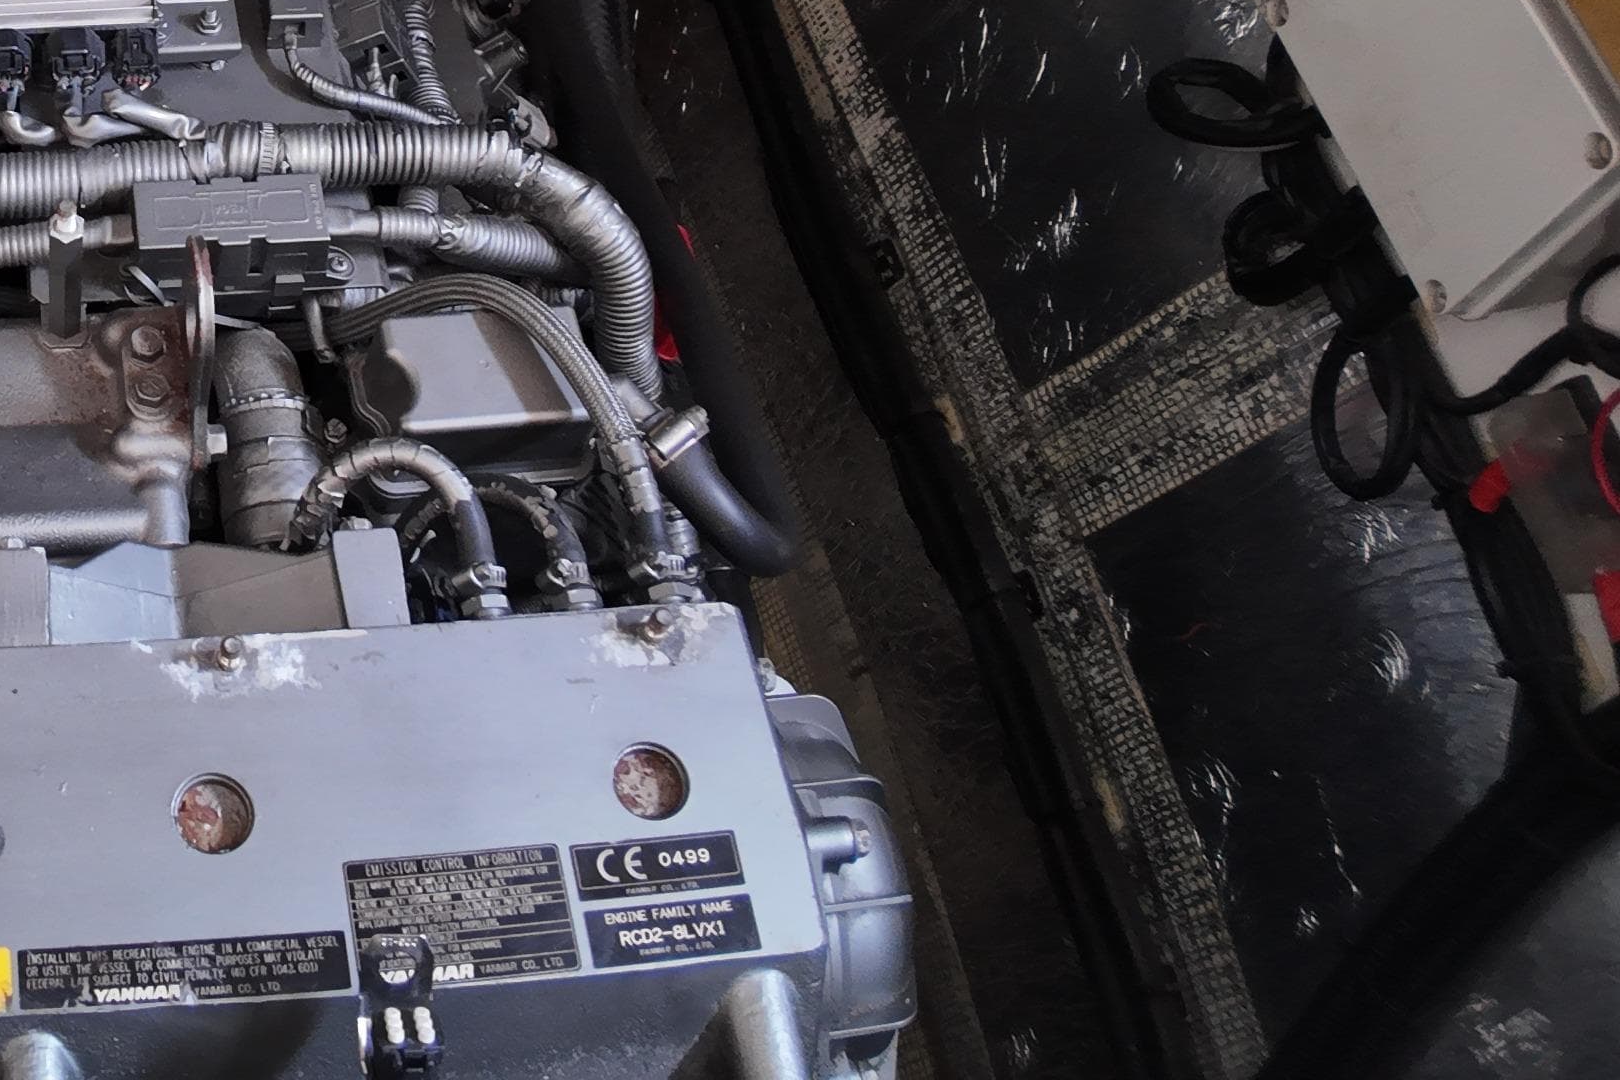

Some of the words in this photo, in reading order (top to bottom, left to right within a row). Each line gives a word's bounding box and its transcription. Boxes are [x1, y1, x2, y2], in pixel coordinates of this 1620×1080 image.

[365, 860, 418, 877] EMISSION
[422, 857, 467, 872] CONTROL
[474, 849, 542, 868] INFORMATION
[596, 846, 648, 883] CE
[658, 848, 711, 867] 0499
[604, 909, 648, 925] ENGINE
[651, 904, 697, 920] FAMILY
[701, 900, 733, 914] NAME
[619, 920, 726, 947] RCD2-8LVX1
[26, 965, 39, 977] OR
[42, 964, 71, 977] USING
[99, 961, 129, 973] VESSEL
[135, 959, 153, 971] FOR
[216, 953, 260, 966] PURPOSES
[263, 952, 282, 963] MAY
[287, 948, 324, 961] VIOLATE
[27, 952, 82, 965] INSTALLING
[87, 950, 109, 962] THIS
[183, 944, 215, 956] ENGINE
[221, 943, 232, 954] IN
[236, 943, 243, 953] A
[306, 936, 339, 948] VESSEL
[26, 977, 65, 990] FEDERAL
[92, 974, 132, 986] SUBJECT
[137, 973, 148, 984] TO
[152, 970, 180, 983] CIVIL
[94, 984, 181, 1003] YANMAR
